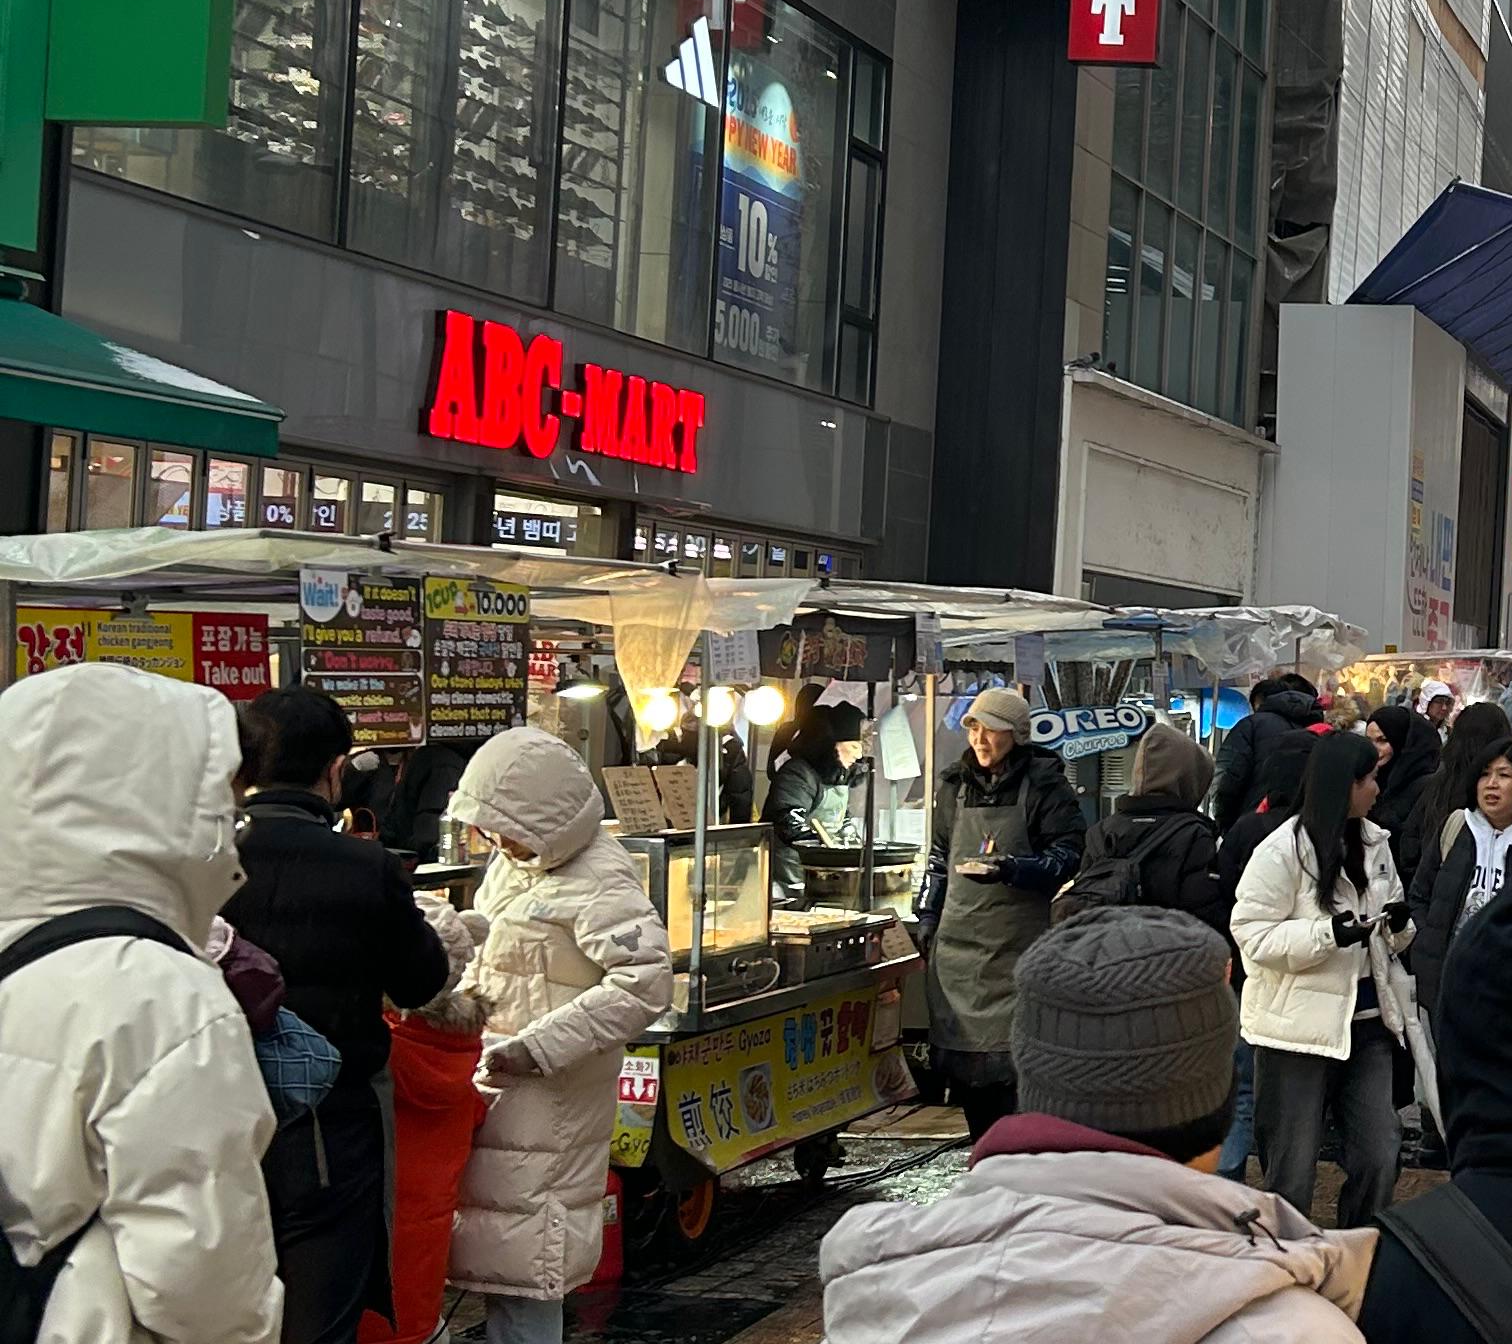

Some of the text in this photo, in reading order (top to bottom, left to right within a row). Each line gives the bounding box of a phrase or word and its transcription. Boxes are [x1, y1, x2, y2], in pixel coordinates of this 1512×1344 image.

[428, 309, 705, 474] ABC-MART
[522, 517, 561, 543] 뱀띠
[303, 582, 339, 608] Wait!
[381, 586, 417, 602] doesn't
[97, 622, 172, 634] Korean traditional
[201, 625, 263, 653] 포장가능
[316, 627, 336, 644] give
[337, 629, 353, 645] you
[97, 635, 129, 648] chicken
[201, 660, 267, 687] Take out
[1030, 708, 1141, 743] OREO
[1064, 733, 1128, 758] Churros
[738, 1026, 772, 1054] Gyoza
[678, 1079, 741, 1148] 煎饺
